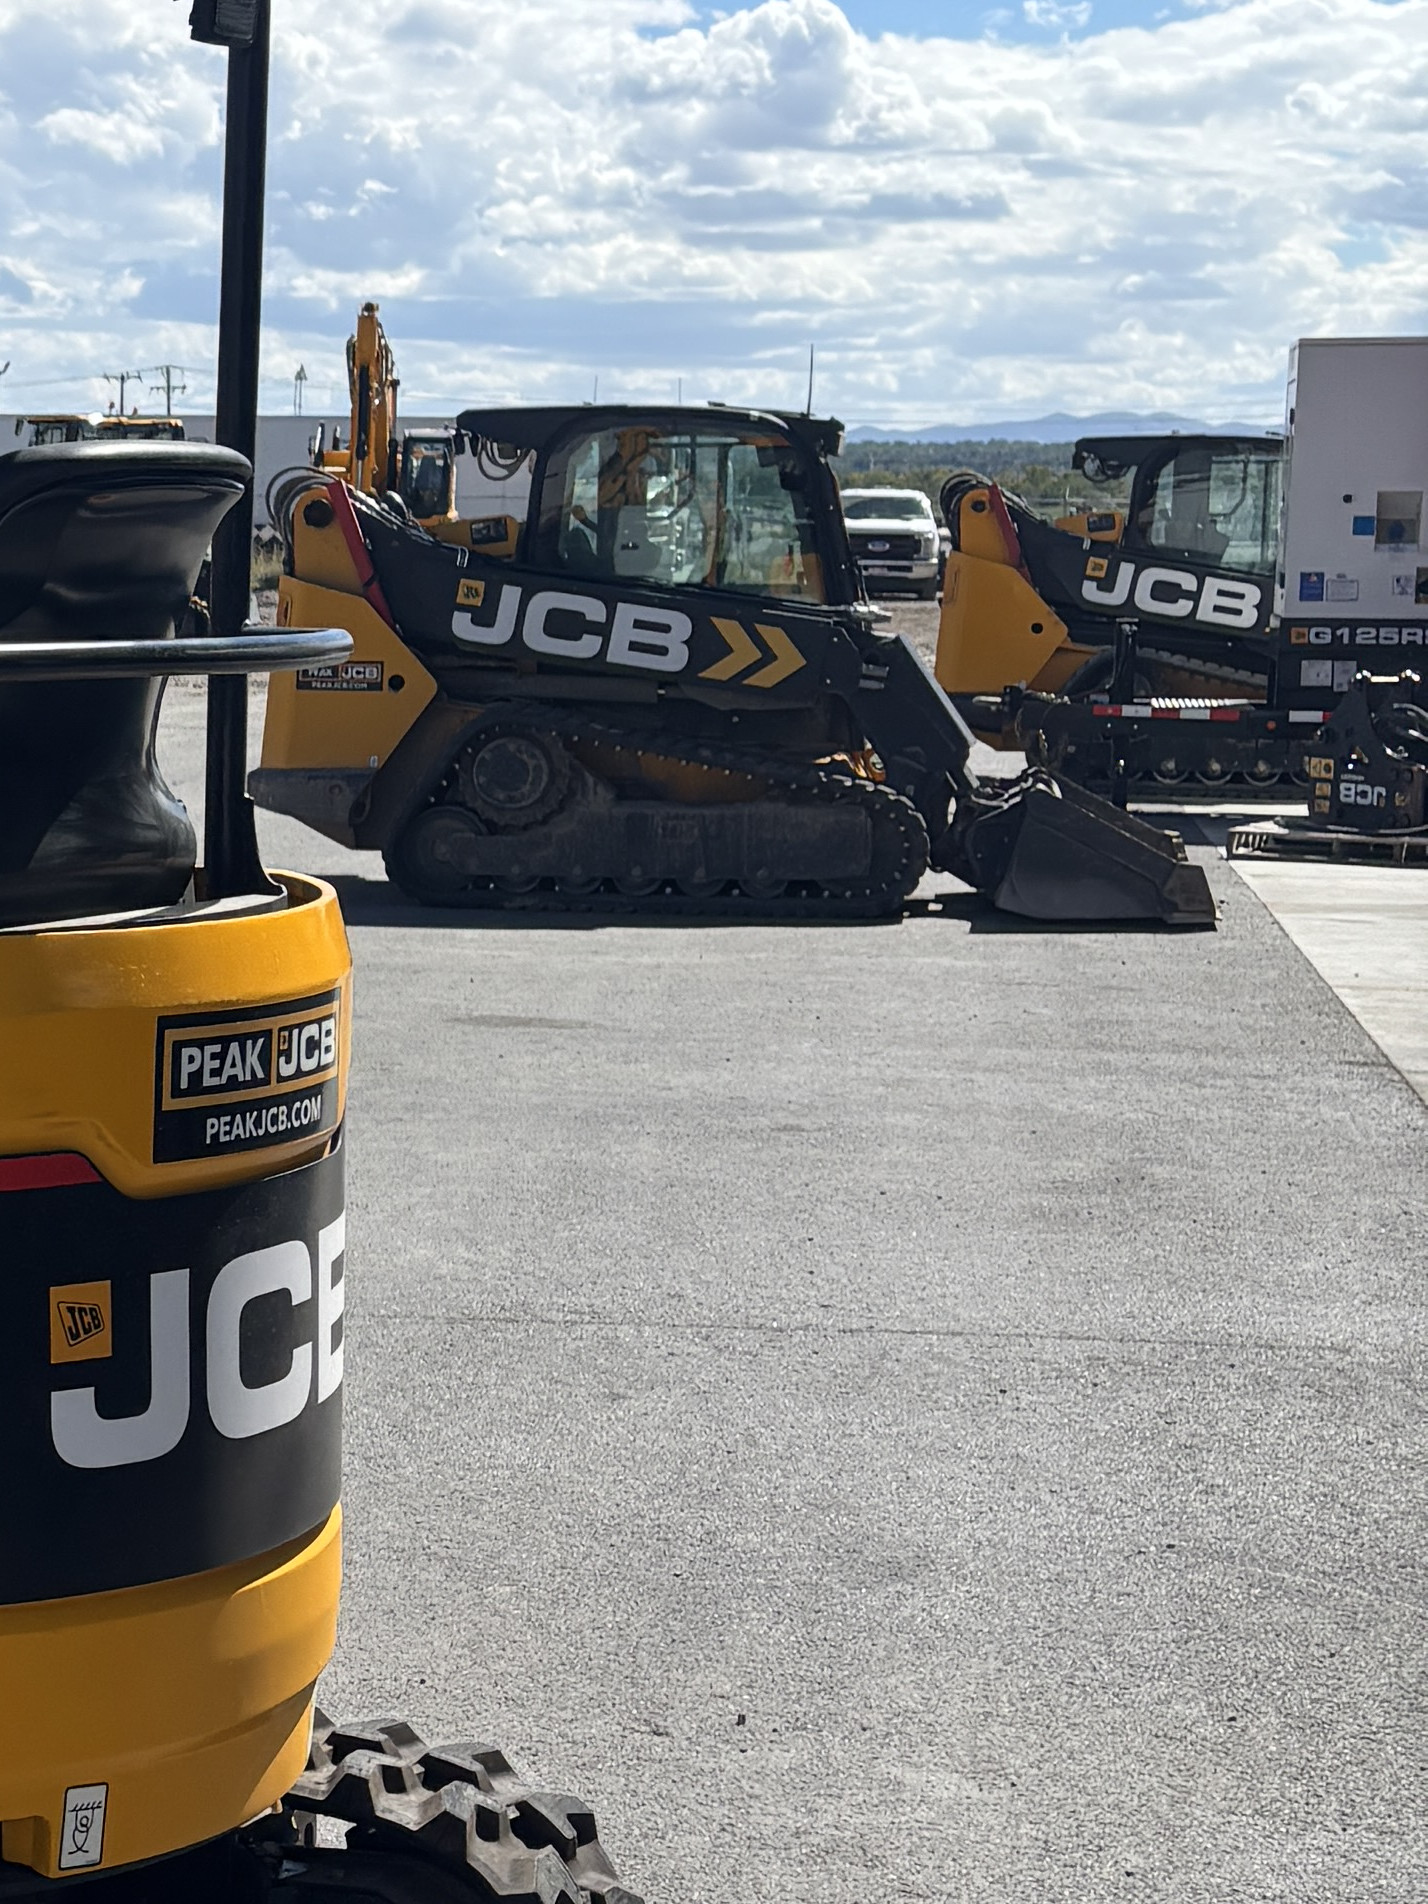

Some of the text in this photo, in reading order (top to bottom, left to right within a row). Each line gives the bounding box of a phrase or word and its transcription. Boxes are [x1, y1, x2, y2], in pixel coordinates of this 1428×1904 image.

[1081, 561, 1262, 629] JCB
[451, 584, 693, 672] JCB
[1309, 627, 1428, 645] G125R
[342, 667, 378, 679] JCB
[1339, 782, 1386, 807] JCB
[180, 1017, 336, 1090] PEAK JCB
[205, 1094, 322, 1145] PEAKJCB.COM
[67, 1305, 102, 1343] JCB
